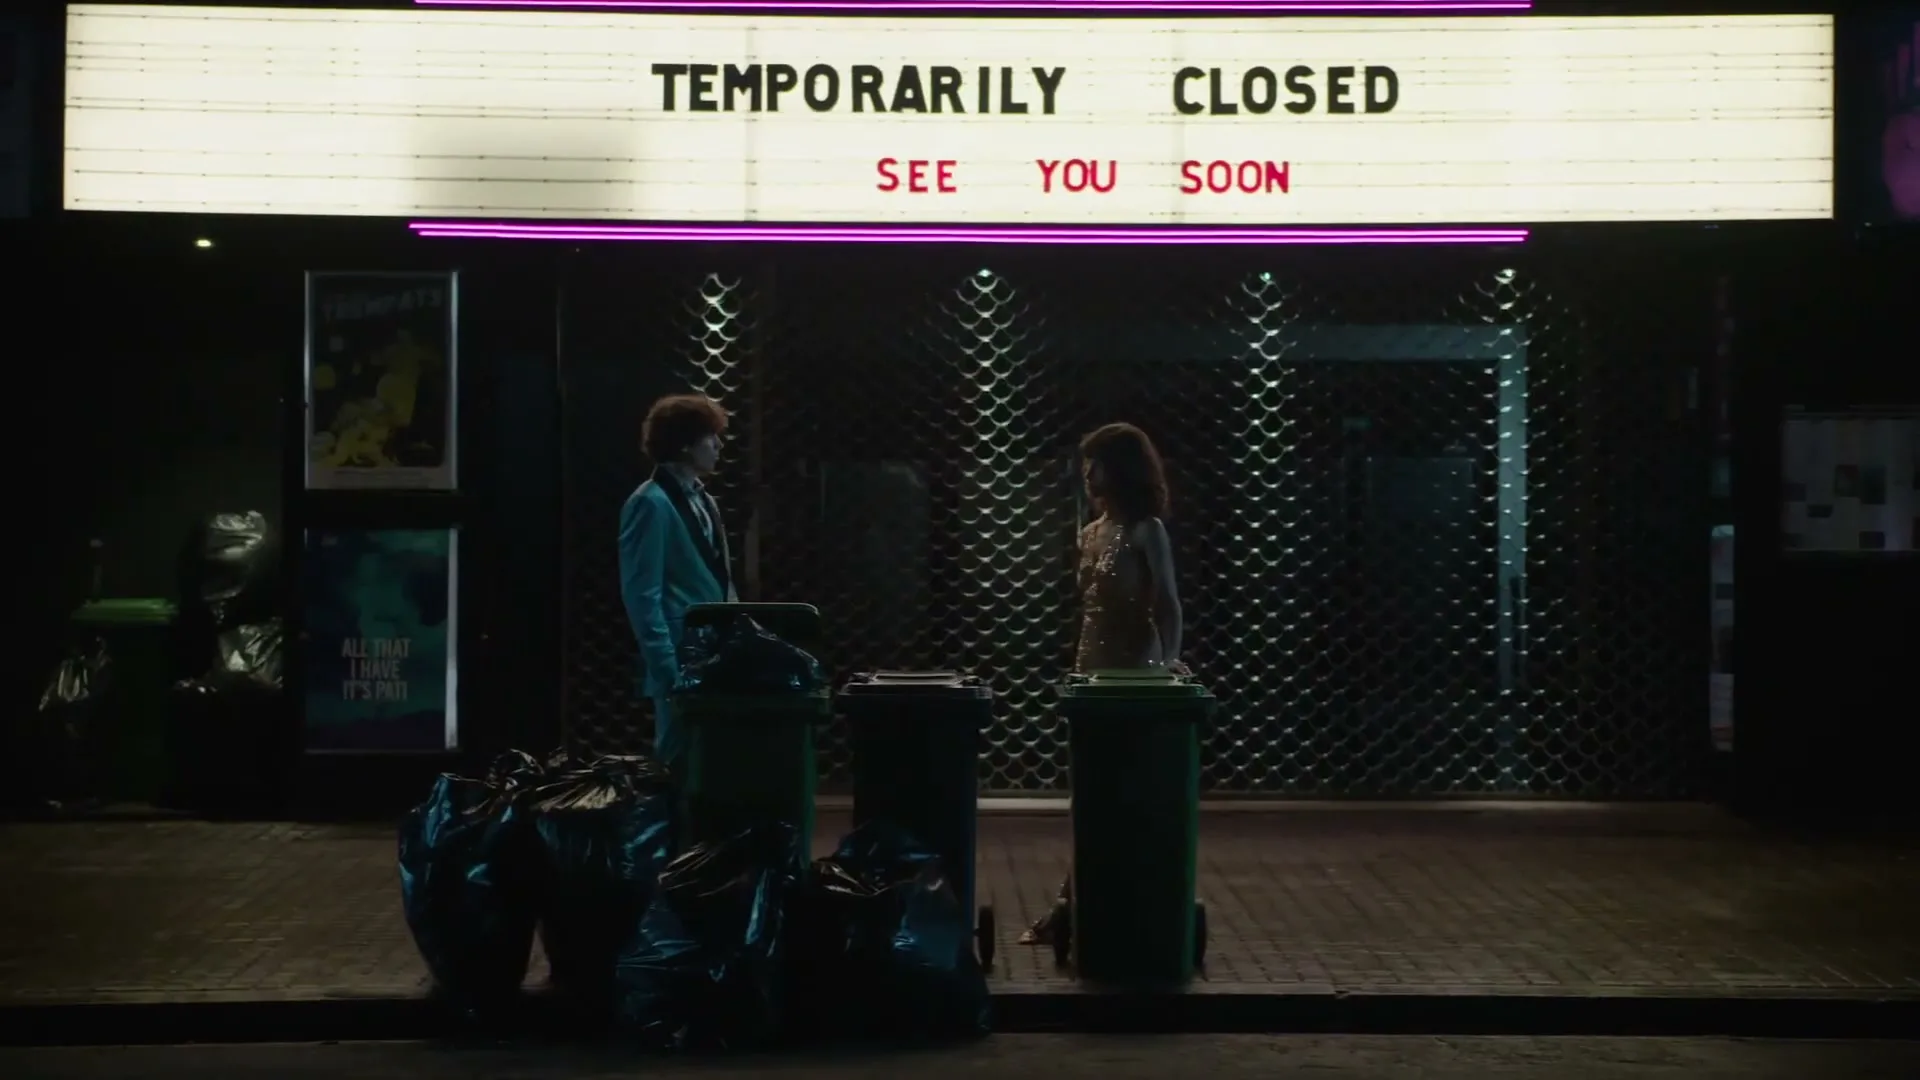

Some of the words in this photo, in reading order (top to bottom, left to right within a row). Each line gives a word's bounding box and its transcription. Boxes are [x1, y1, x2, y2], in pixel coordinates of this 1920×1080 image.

[652, 64, 1065, 114] TEMPORARILY
[1174, 66, 1398, 115] CLOSED
[878, 158, 956, 193] SEE
[1039, 159, 1116, 193] YOU
[1183, 160, 1289, 194] SOON
[341, 637, 369, 658] ALL
[373, 637, 412, 658] THAT
[360, 659, 401, 680] HAVE
[343, 680, 372, 701] IT'S
